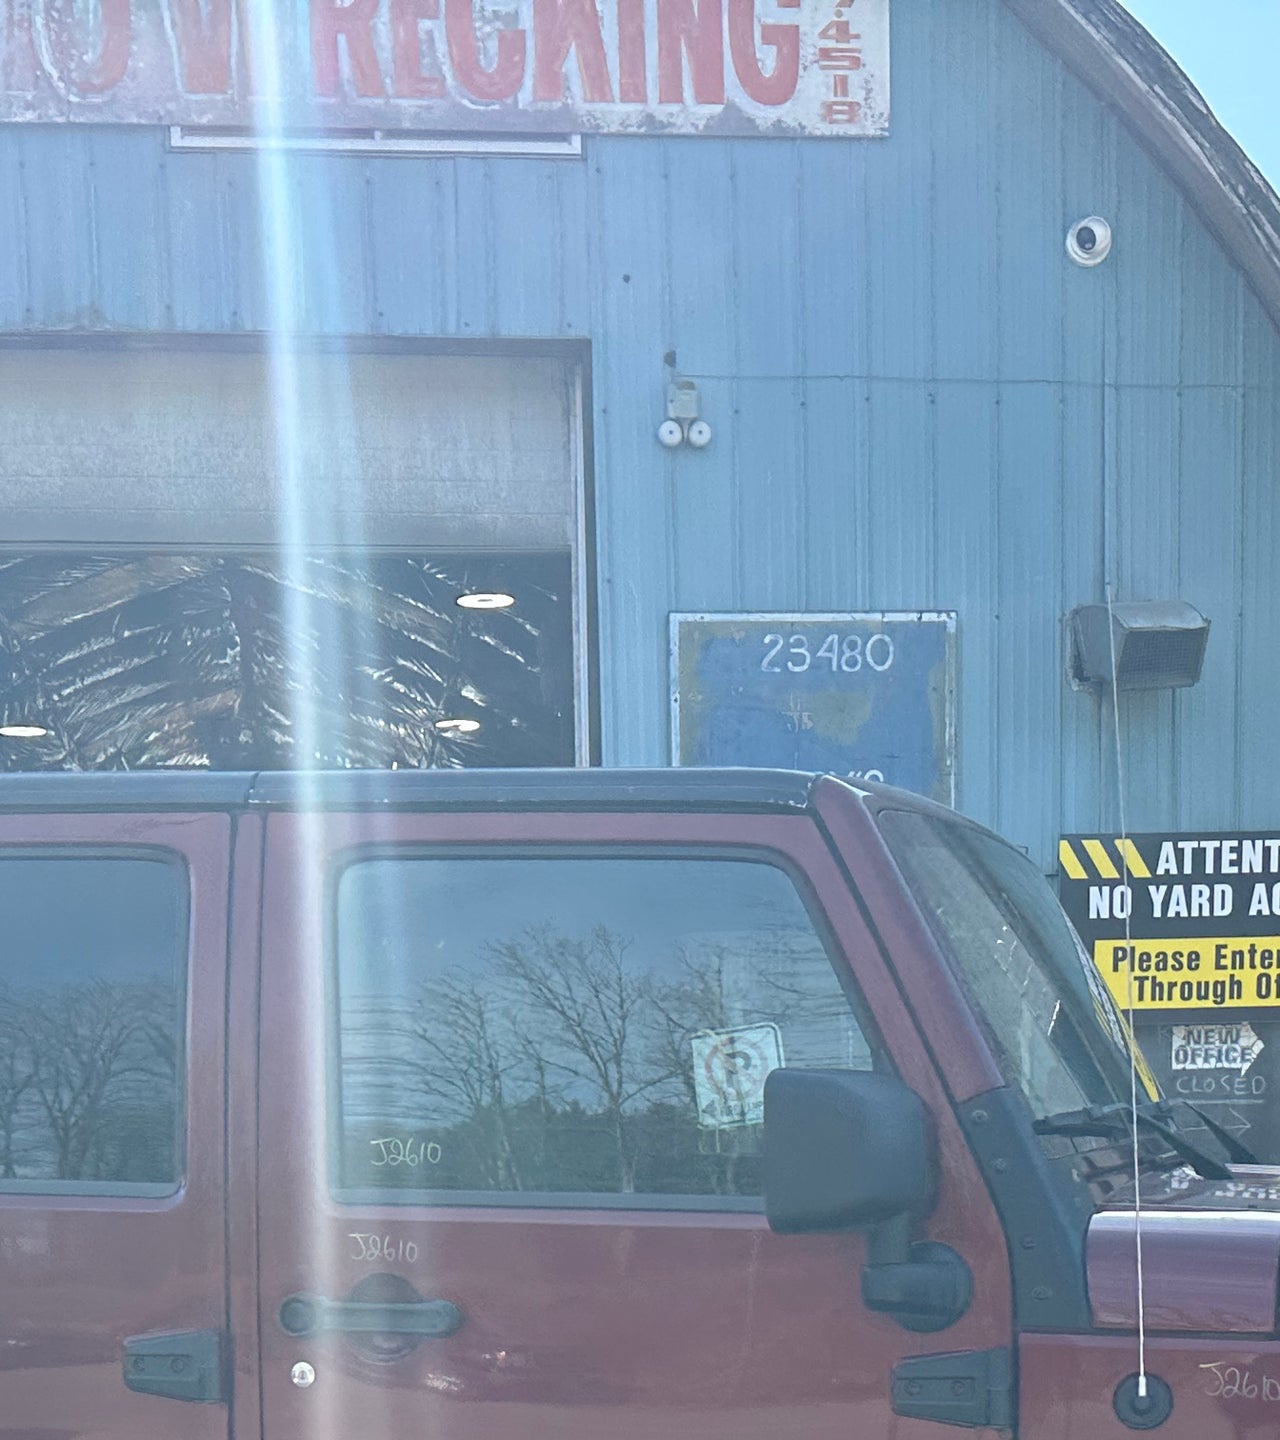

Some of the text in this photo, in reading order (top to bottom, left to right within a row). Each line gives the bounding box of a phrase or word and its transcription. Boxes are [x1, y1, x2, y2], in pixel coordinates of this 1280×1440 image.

[760, 633, 896, 673] 23480
[1088, 885, 1133, 919] NO
[1148, 884, 1233, 918] YARD
[1112, 944, 1201, 973] Please
[1133, 975, 1243, 1005] Through
[1184, 1026, 1241, 1045] NEW
[1175, 1044, 1253, 1066] OFFICE
[1176, 1074, 1266, 1095] CLOSED
[370, 1138, 442, 1167] J2610
[348, 1233, 418, 1263] J2610
